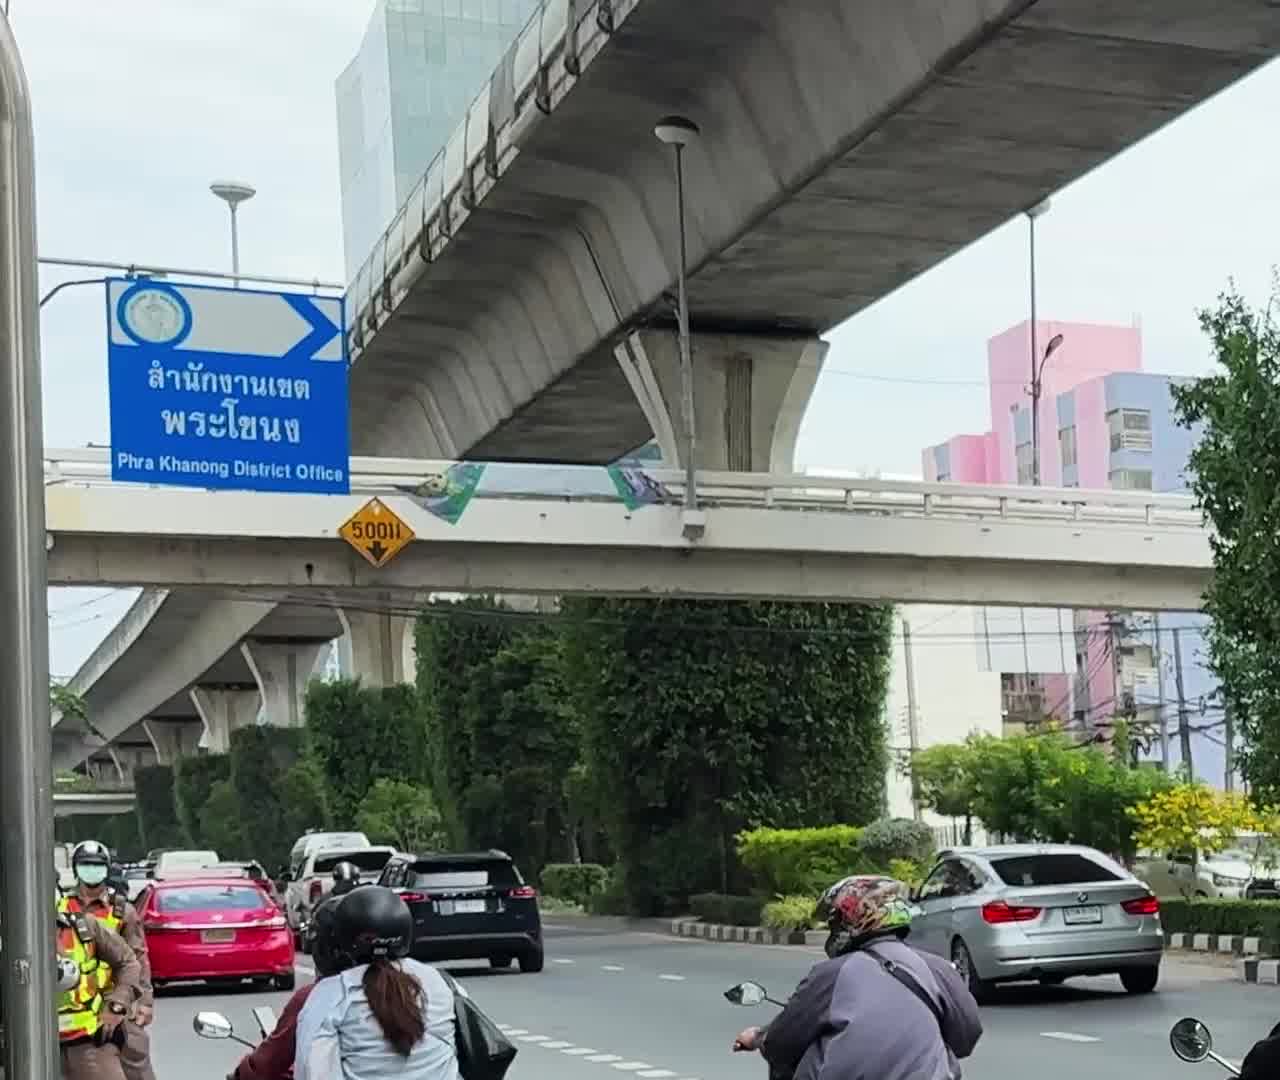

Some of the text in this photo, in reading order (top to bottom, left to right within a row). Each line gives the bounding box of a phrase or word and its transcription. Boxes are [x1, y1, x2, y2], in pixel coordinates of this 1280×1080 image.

[148, 359, 310, 400] สำนักงานเขต
[161, 398, 300, 443] พระโขนง
[117, 452, 344, 482] Phra Khanong District Office
